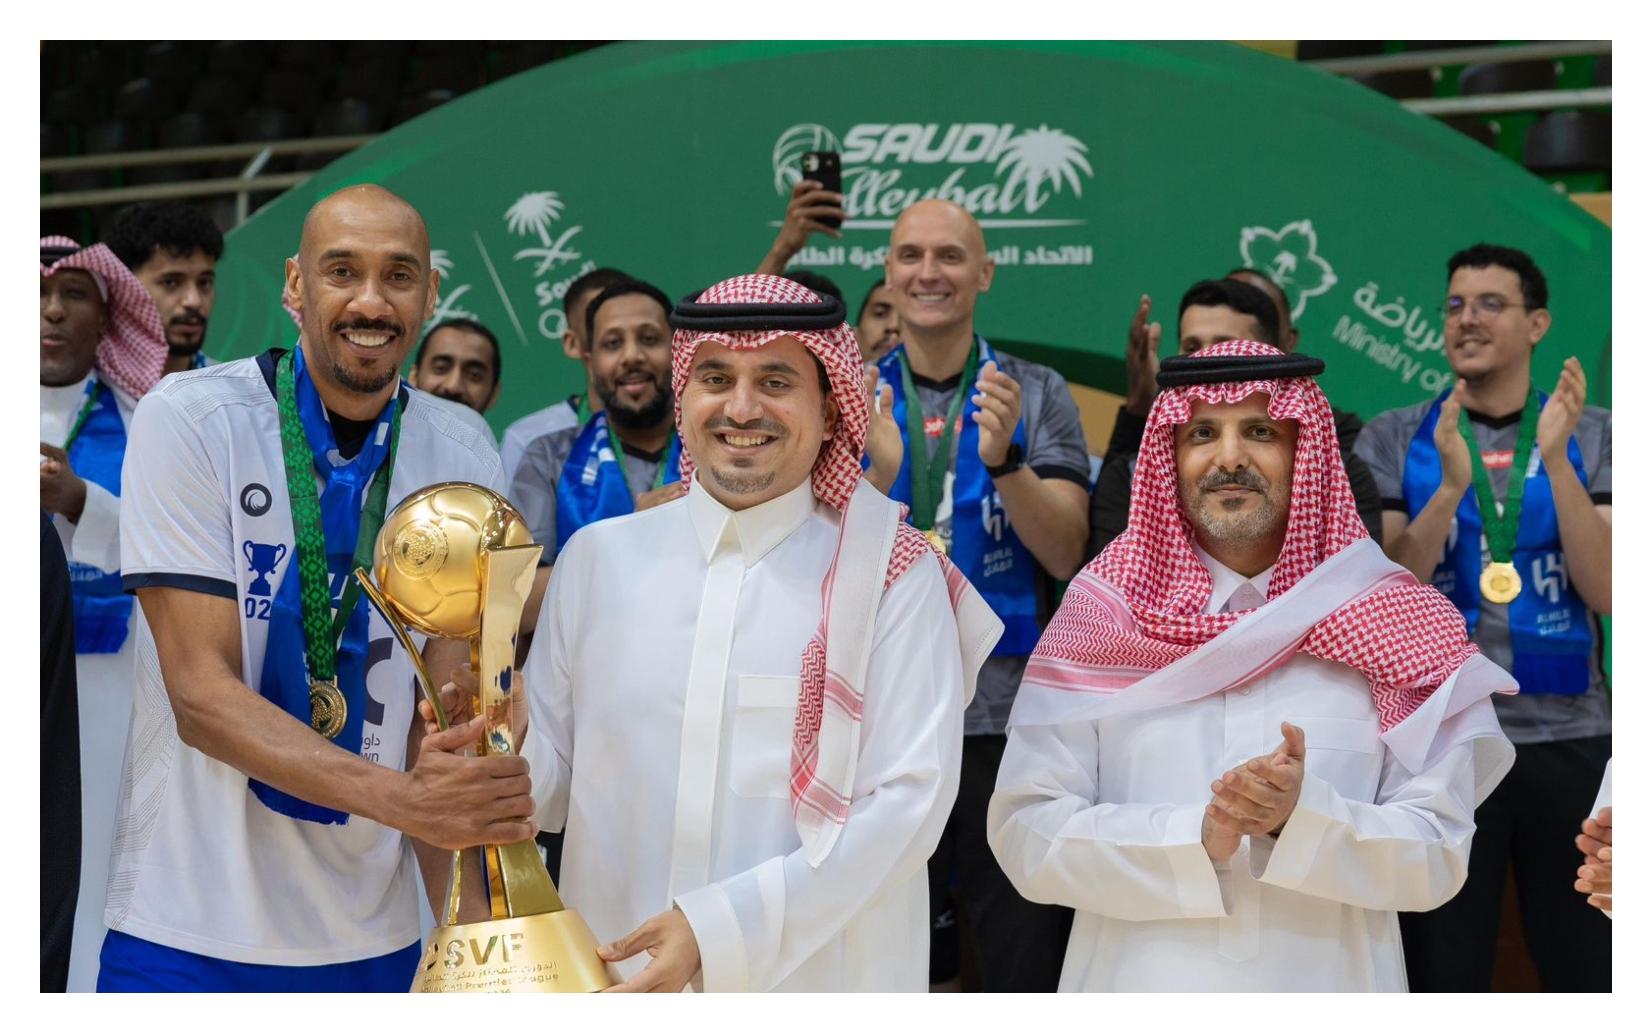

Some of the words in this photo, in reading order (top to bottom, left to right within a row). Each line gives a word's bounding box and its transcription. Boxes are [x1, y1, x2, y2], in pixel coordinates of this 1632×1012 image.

[841, 123, 1014, 164] SAUDI
[1024, 245, 1093, 266] الاتحاد
[1332, 314, 1423, 384] Ministry
[444, 933, 524, 969] SVF
